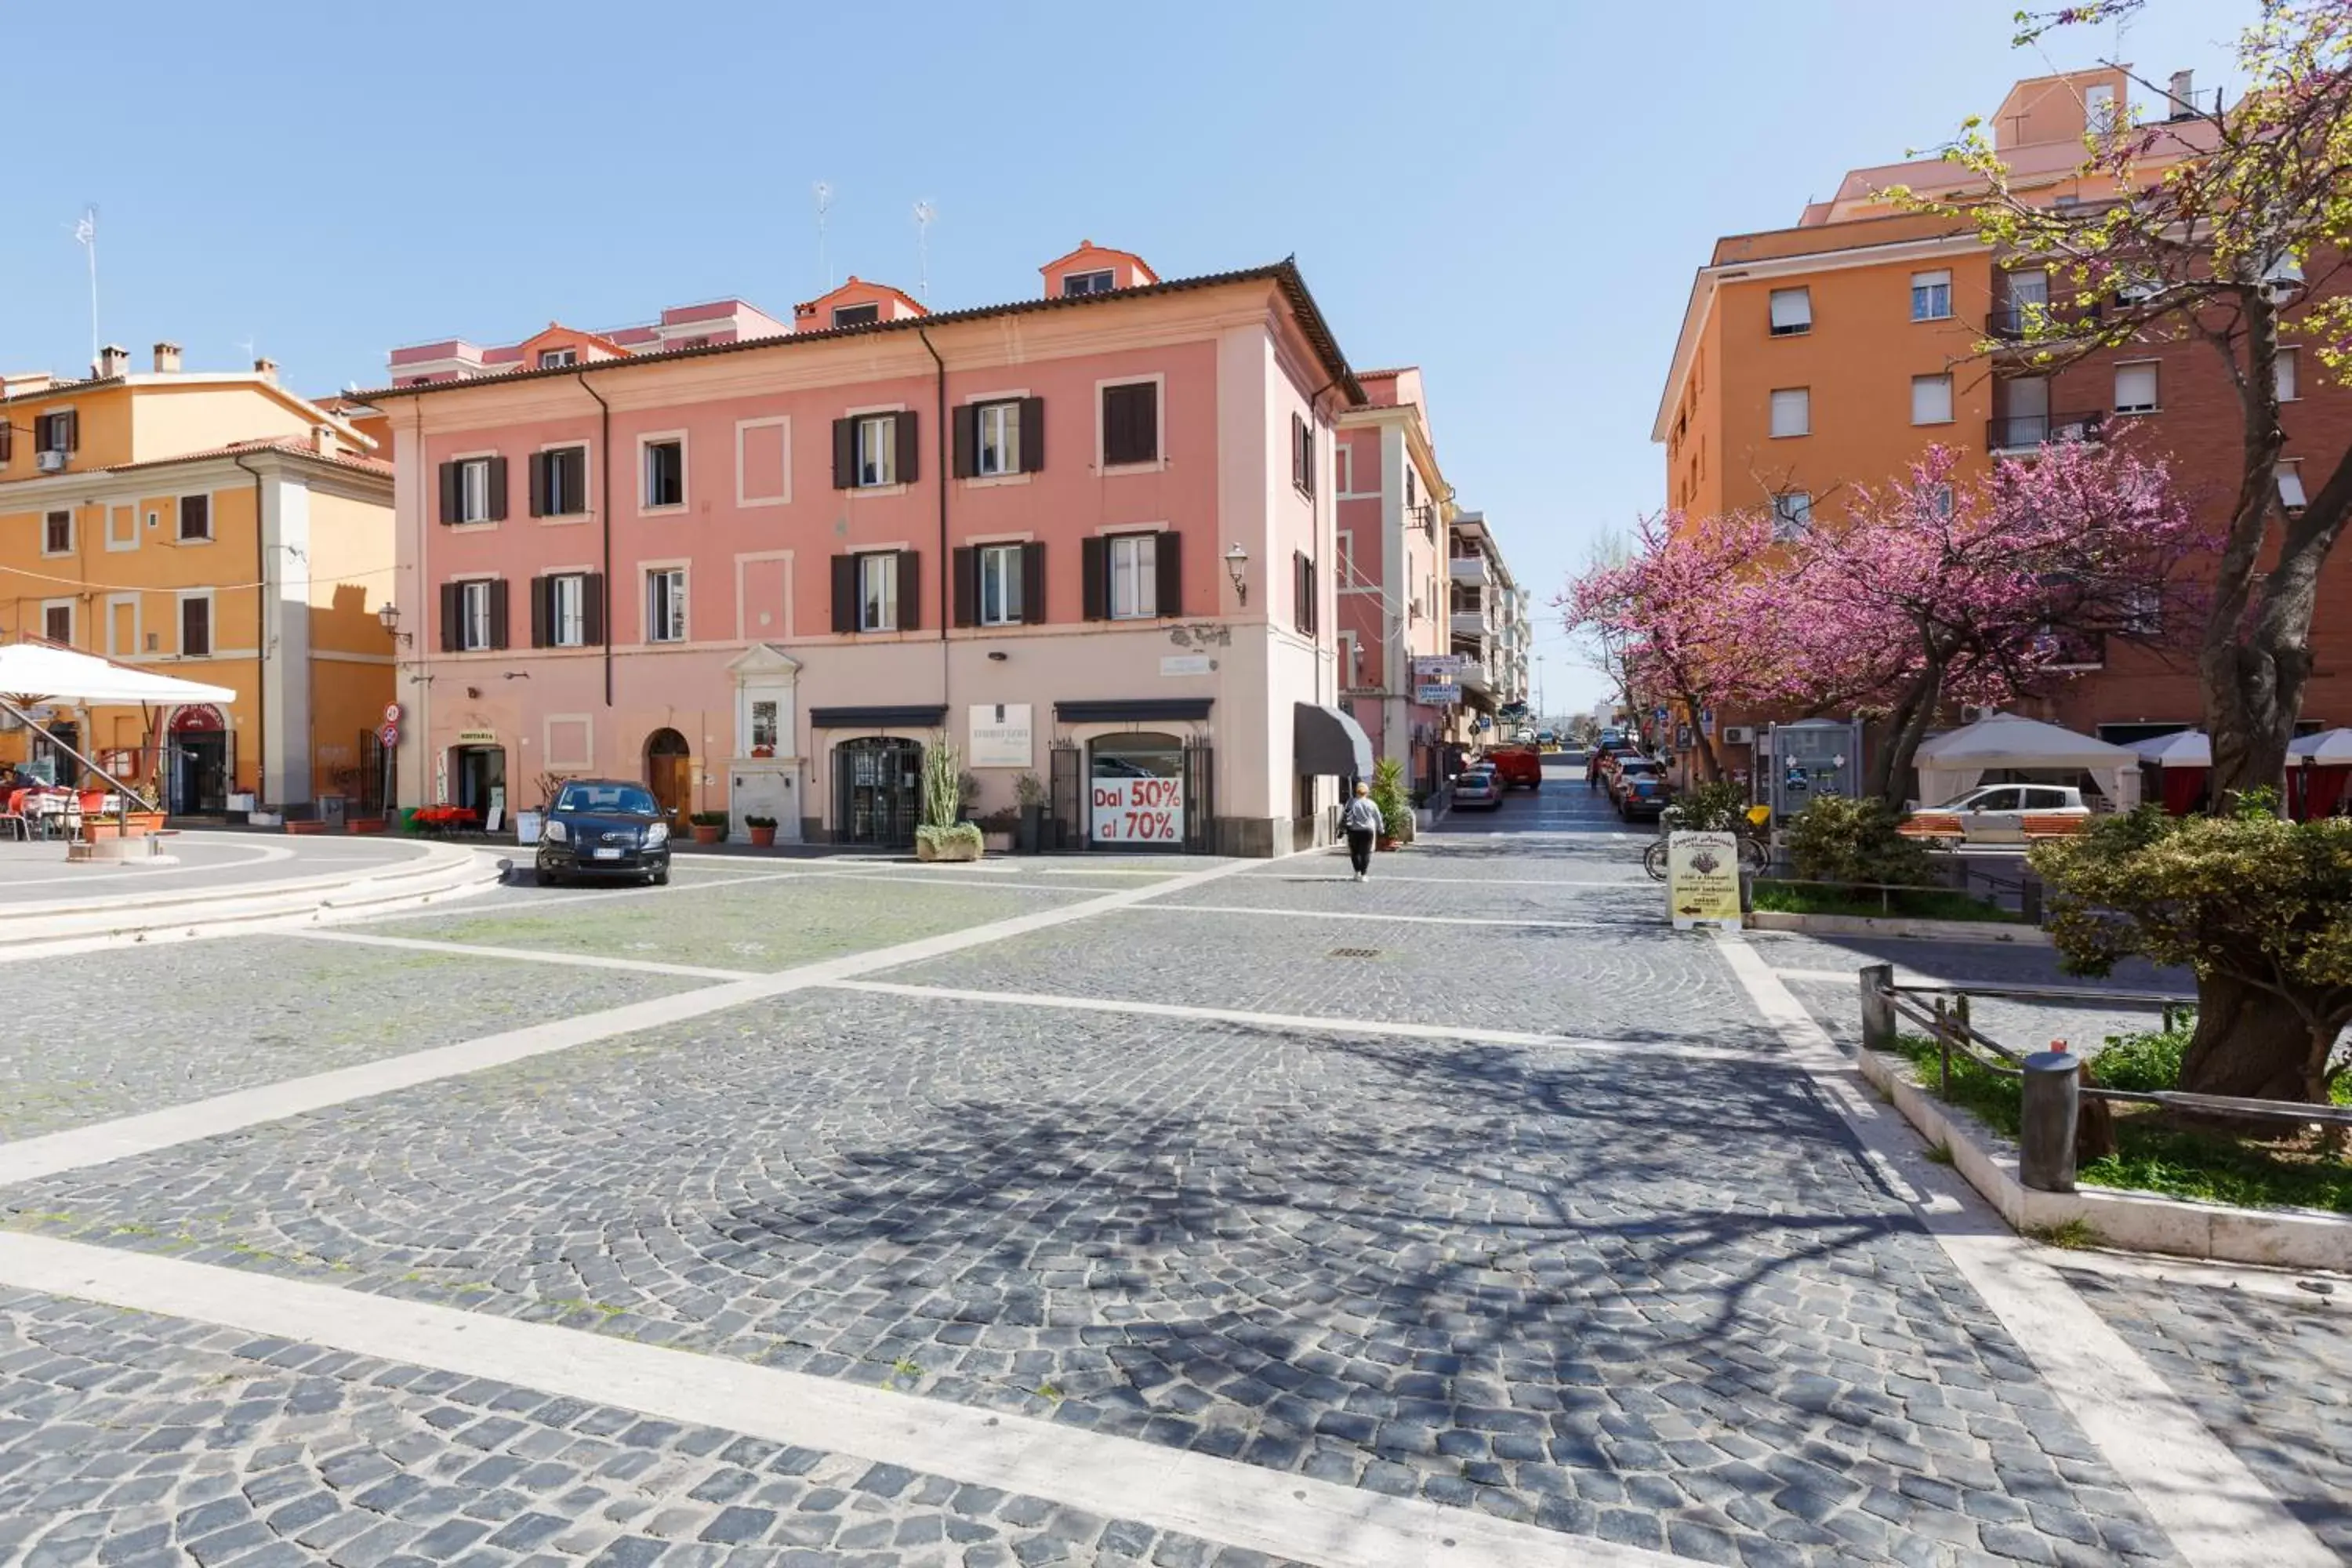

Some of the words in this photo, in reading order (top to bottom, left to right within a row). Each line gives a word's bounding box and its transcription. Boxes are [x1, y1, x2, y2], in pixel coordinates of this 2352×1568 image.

[1094, 786, 1122, 807] Dal
[1131, 780, 1180, 808] 50%
[1102, 818, 1116, 838] al
[1123, 812, 1174, 839] 70%
